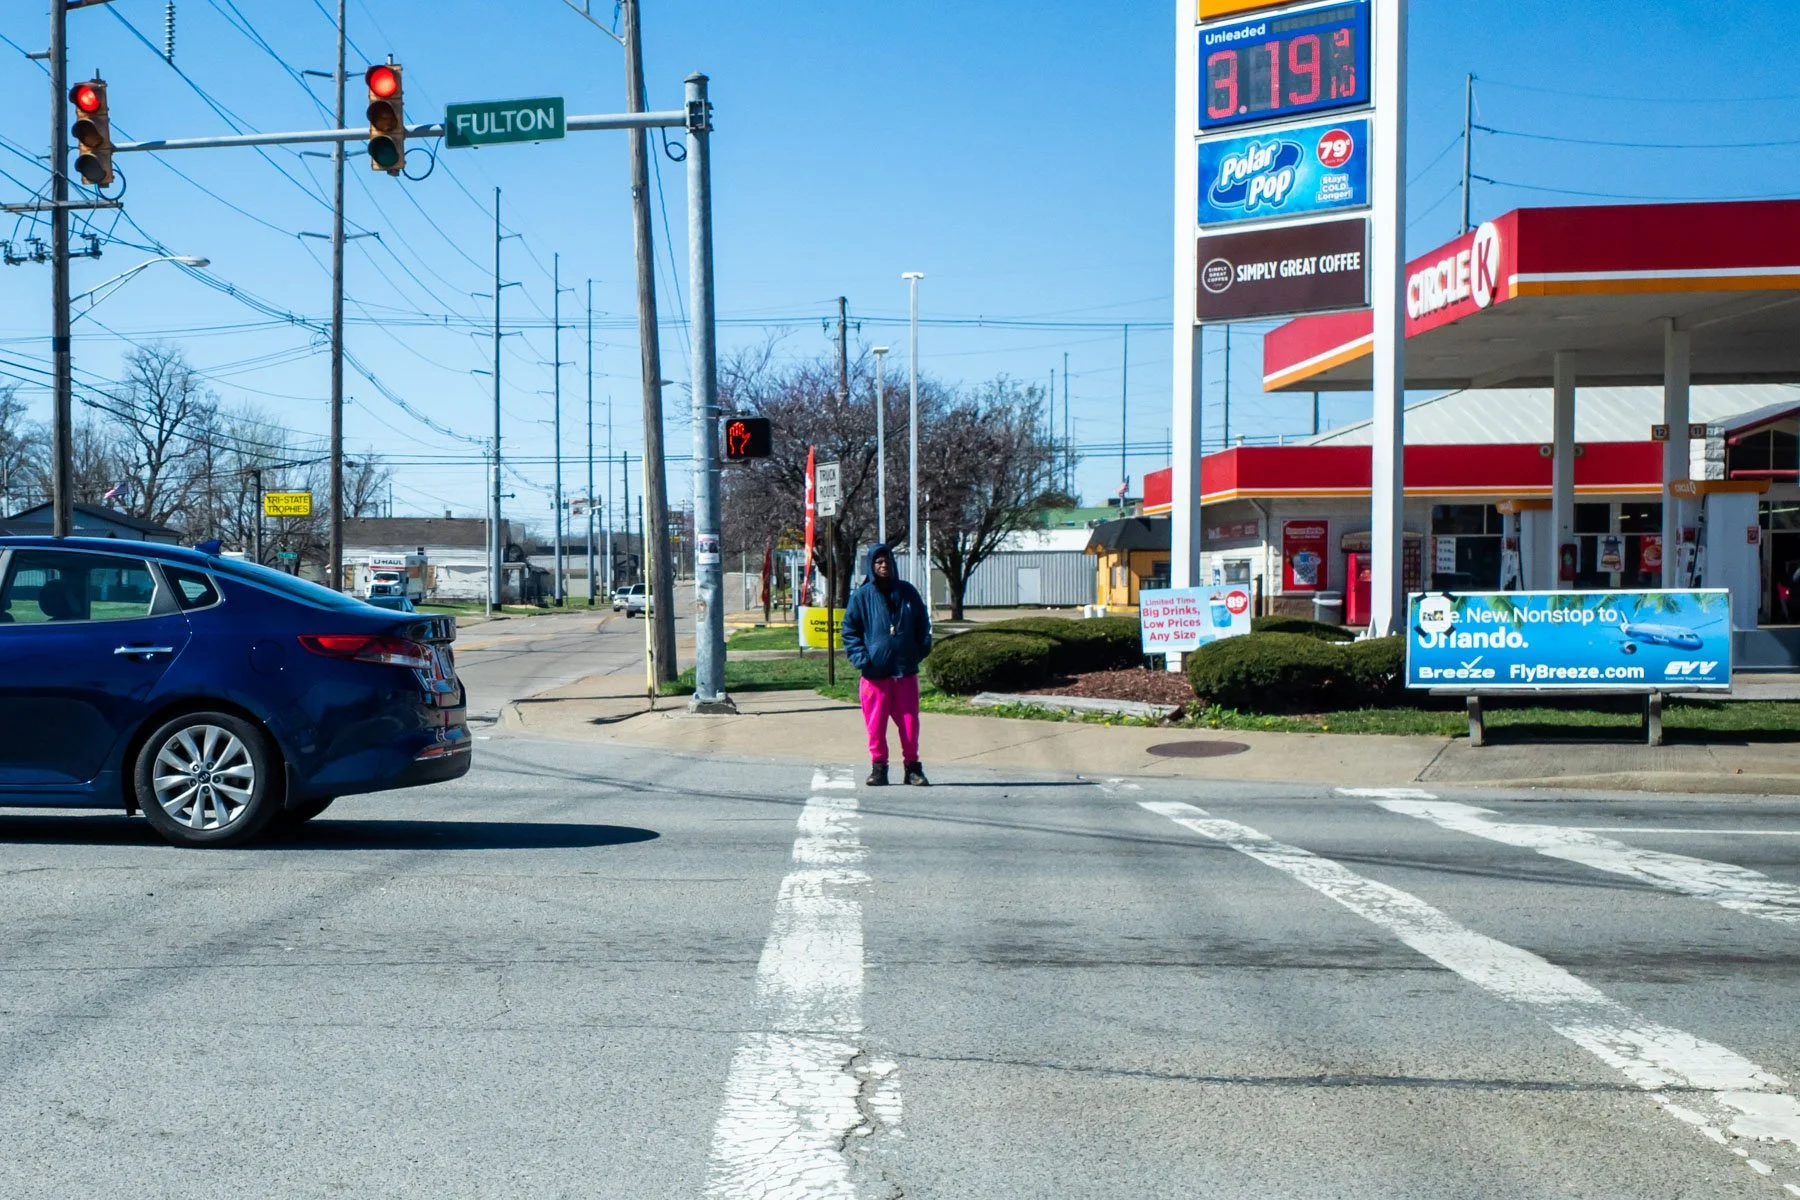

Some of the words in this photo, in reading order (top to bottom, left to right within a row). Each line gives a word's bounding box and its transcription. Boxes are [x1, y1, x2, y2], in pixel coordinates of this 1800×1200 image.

[1205, 23, 1266, 45] Unleaded
[1207, 34, 1321, 119] 3.19
[456, 107, 555, 136] FULTON
[1221, 144, 1277, 186] Polar
[1322, 175, 1347, 184] Stays
[1248, 169, 1291, 206] Pop
[1322, 182, 1347, 192] COLD
[1317, 190, 1351, 201] Longer!
[1236, 261, 1278, 282] SIMPLY
[1279, 257, 1317, 278] GREAT
[1319, 252, 1361, 273] COFFEE
[1407, 249, 1471, 320] CIRCLE
[819, 468, 836, 482] TRUCK
[819, 484, 837, 498] ROUTE
[267, 495, 309, 504] TRI-STATE
[268, 504, 309, 513] TROPHIES
[1145, 597, 1174, 606] Limited
[1176, 597, 1196, 605] Time
[1142, 607, 1159, 618] Big
[1162, 605, 1200, 616] Drinks,
[1467, 607, 1510, 623] New.
[1514, 606, 1595, 626] Nonstop
[1598, 607, 1618, 622] to
[1143, 620, 1164, 629] Low
[1167, 618, 1201, 628] Prices
[1149, 632, 1170, 642] Any
[1173, 631, 1196, 640] Size
[1419, 665, 1496, 679] Breeze
[1509, 664, 1645, 682] FlyBreeze.com
[1664, 660, 1719, 675] EVV
